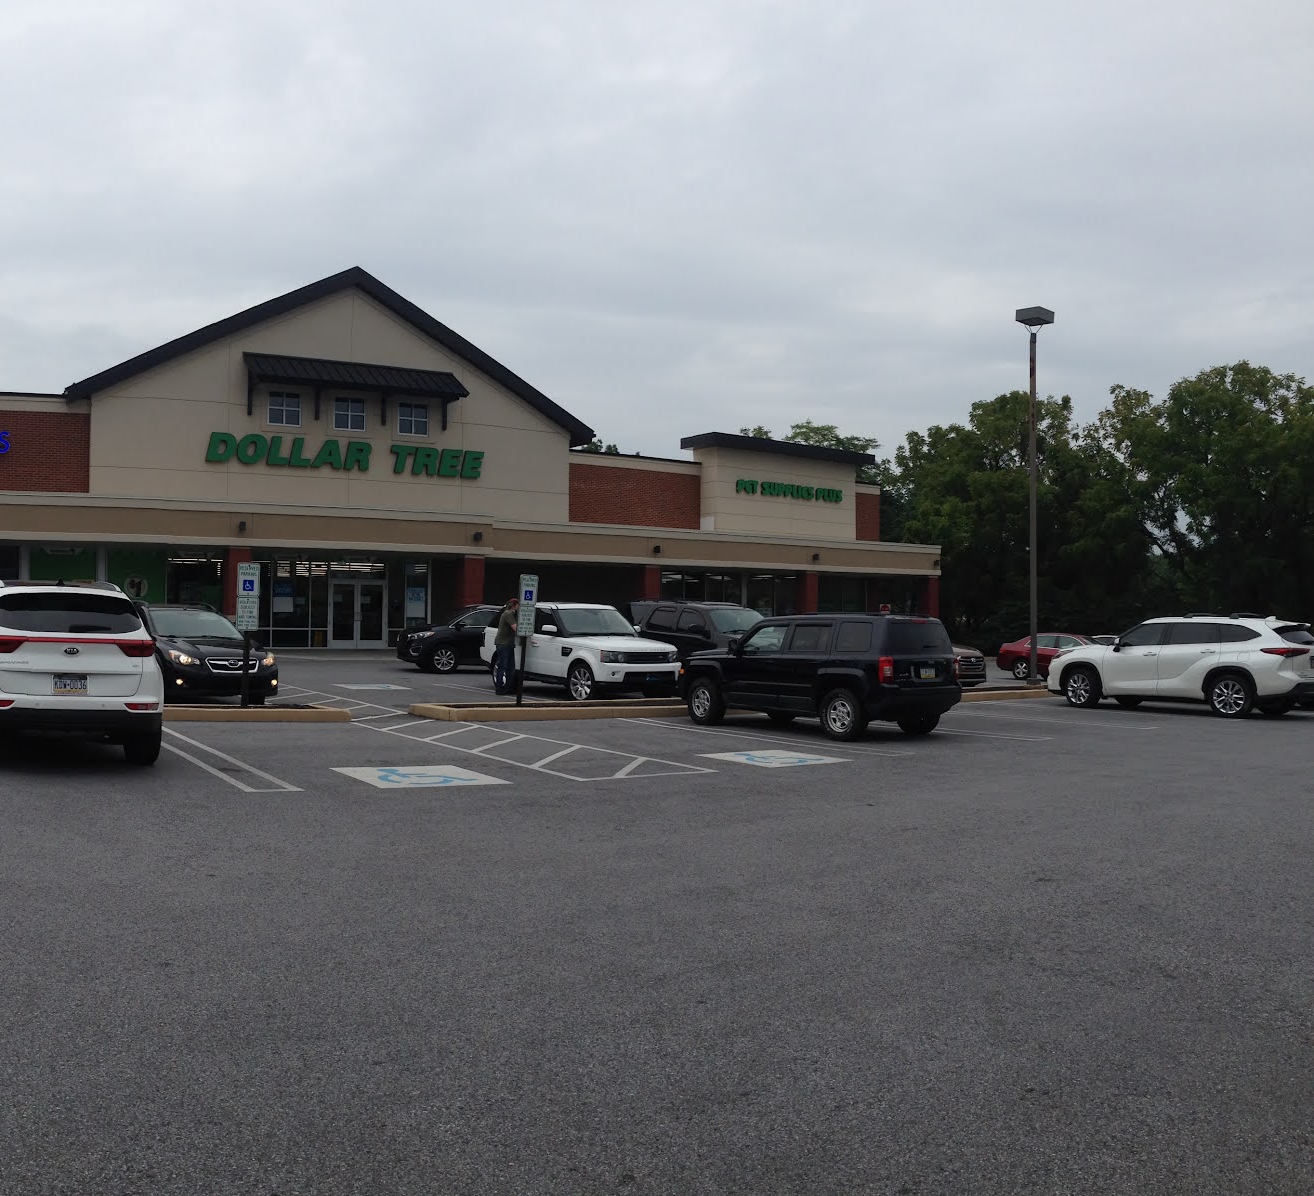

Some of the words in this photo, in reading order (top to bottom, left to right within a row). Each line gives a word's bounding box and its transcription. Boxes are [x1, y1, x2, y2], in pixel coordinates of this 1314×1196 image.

[205, 431, 372, 471] DOLLAR
[390, 444, 485, 479] TREE
[736, 479, 759, 494] PET
[760, 481, 815, 499] SUPPLIES
[815, 487, 843, 503] PLUS
